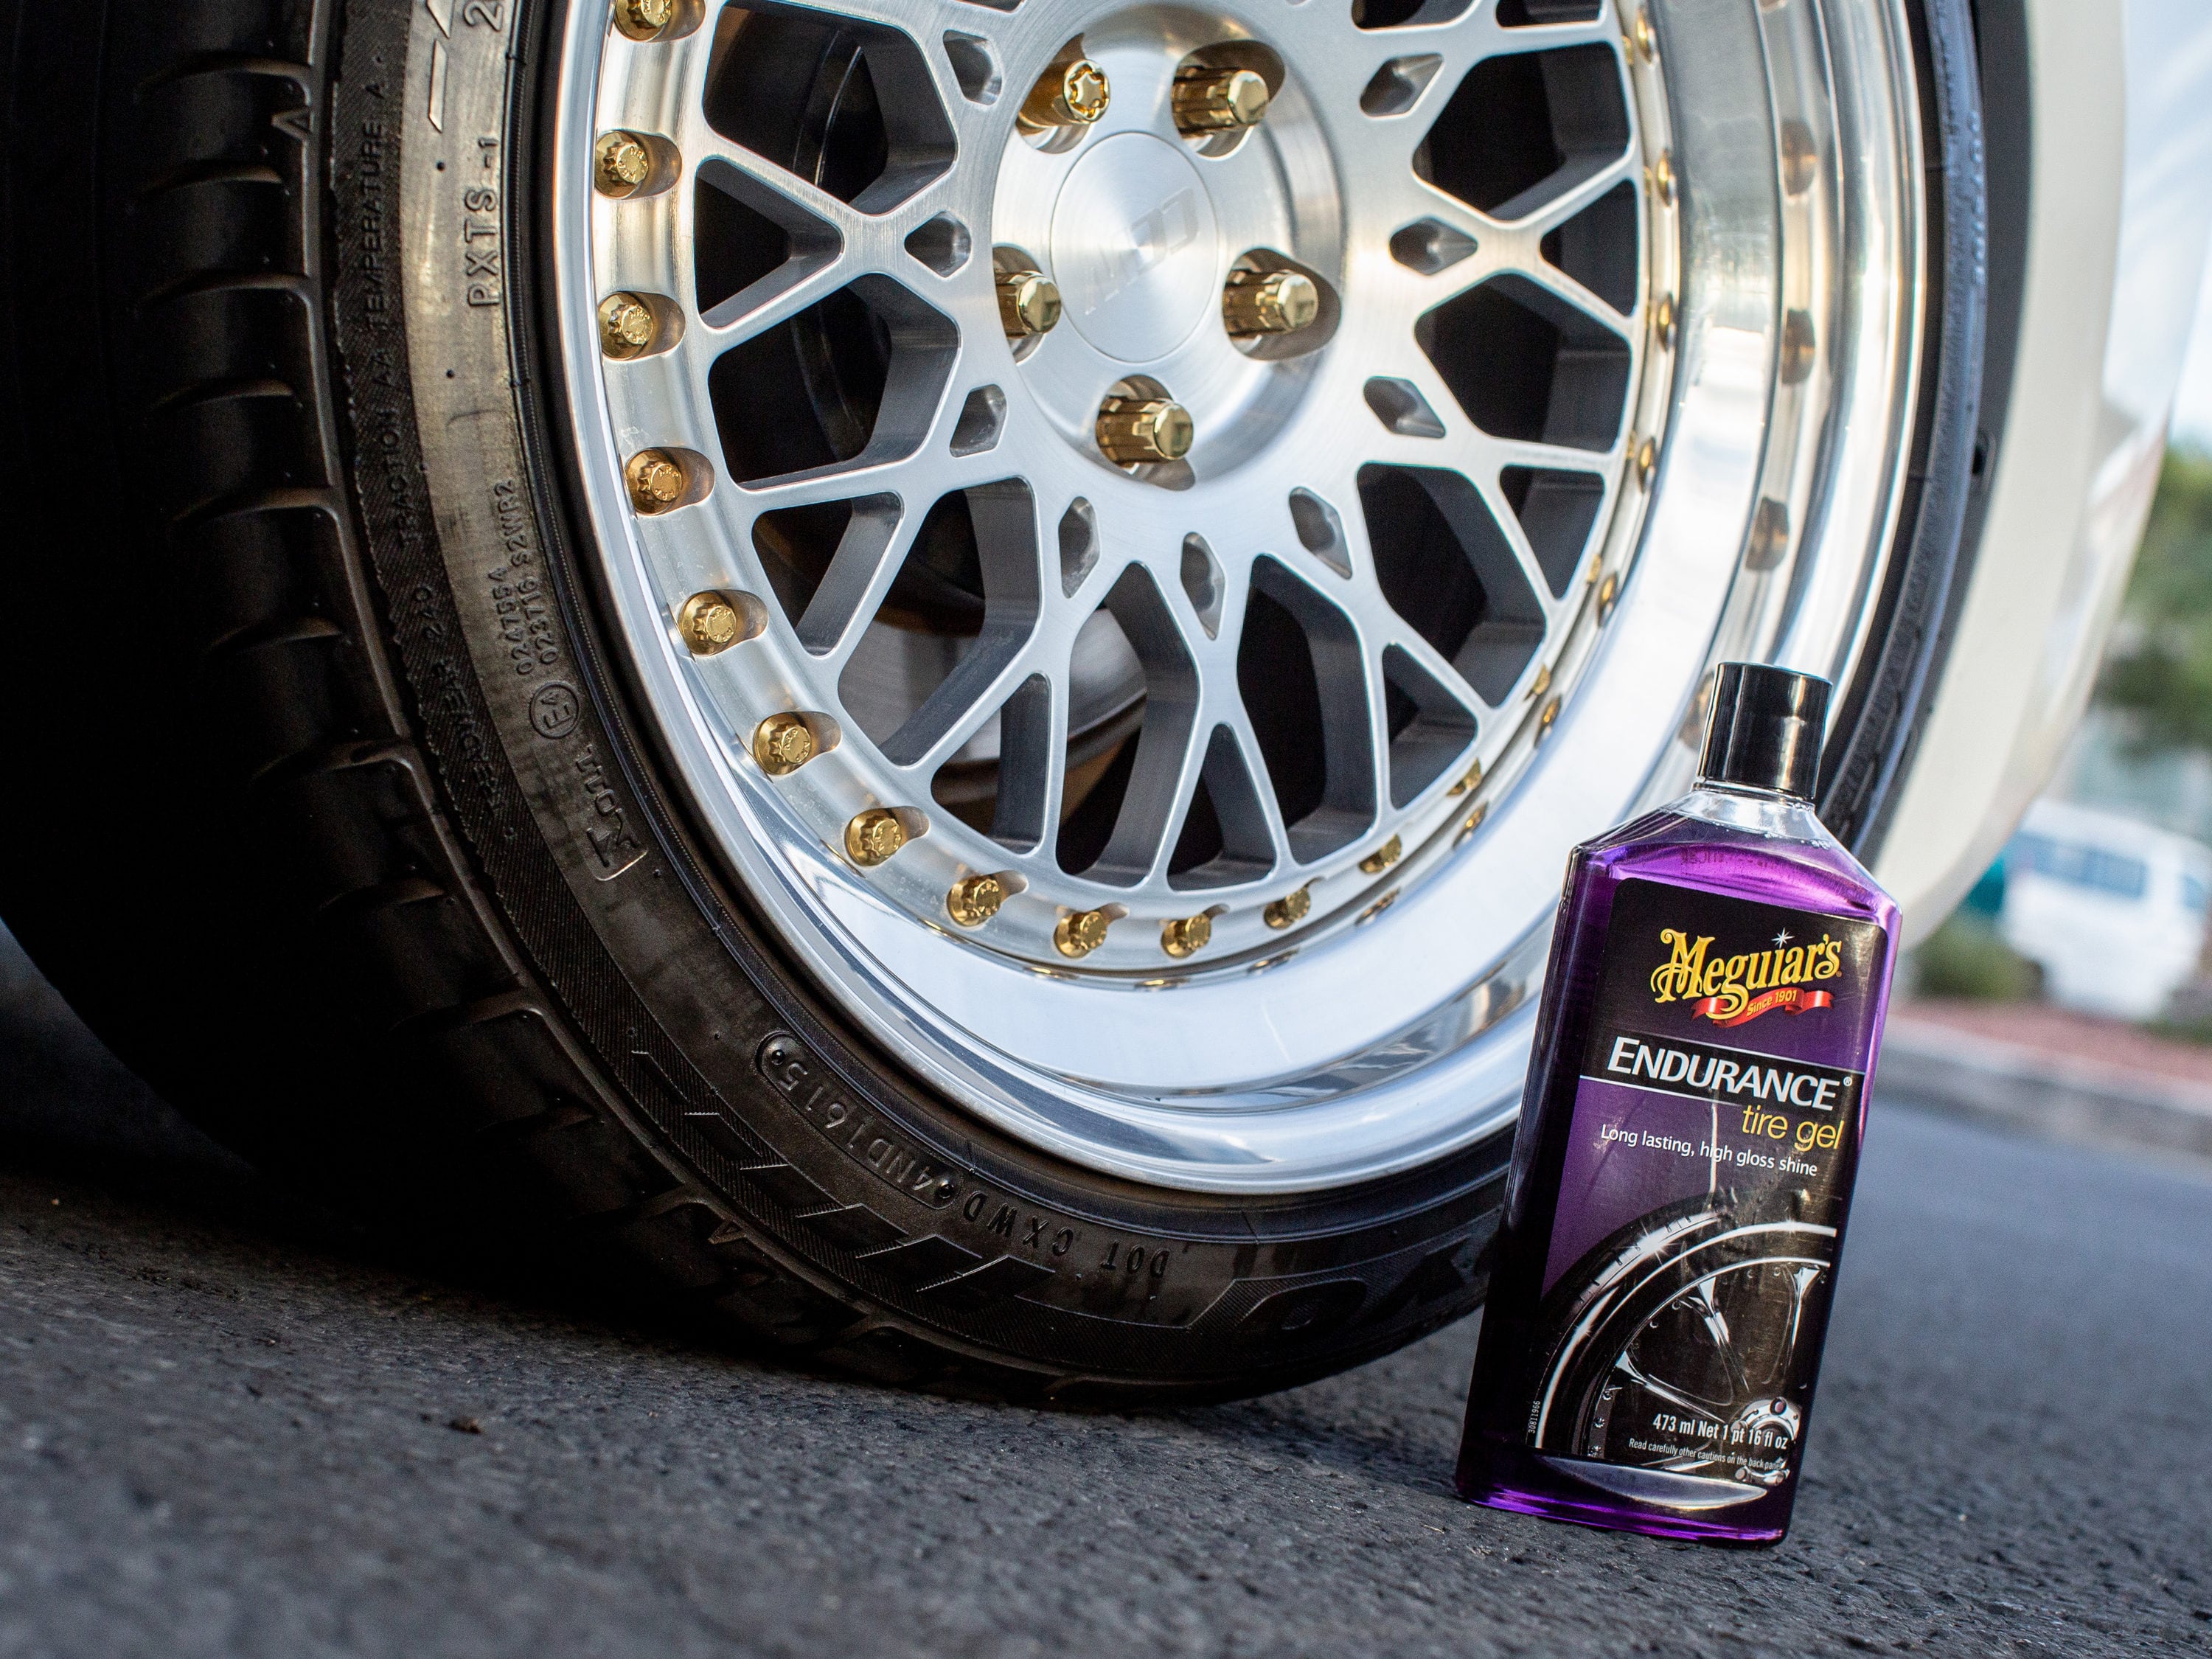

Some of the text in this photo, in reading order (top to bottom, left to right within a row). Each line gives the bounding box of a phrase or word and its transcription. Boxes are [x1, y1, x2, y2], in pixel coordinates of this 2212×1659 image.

[361, 122, 389, 331] TEMPERATURE
[465, 136, 501, 307] PXTS-1
[518, 575, 560, 665] 023716
[1650, 928, 1843, 1020] Meguiar's
[1746, 990, 1798, 1017] Since 1901
[1600, 1123, 1818, 1177] Long lasting, high gloss shine
[1742, 1105, 1845, 1152] tire gel
[1102, 1240, 1171, 1279] DOT
[1528, 1400, 1540, 1434] 30811966
[1652, 1413, 1677, 1432] 473
[1679, 1419, 1696, 1436] ml
[1697, 1421, 1719, 1440] Net
[1722, 1424, 1729, 1441] 1
[1731, 1427, 1745, 1445] pt
[1748, 1429, 1761, 1446] 16
[1775, 1436, 1789, 1450] oz
[1629, 1438, 1646, 1450] Read
[1648, 1442, 1678, 1456] carefully
[1679, 1448, 1697, 1458] other
[1697, 1450, 1726, 1462] cautions
[1727, 1455, 1736, 1464] on
[1736, 1455, 1747, 1466] the
[1748, 1458, 1764, 1469] back
